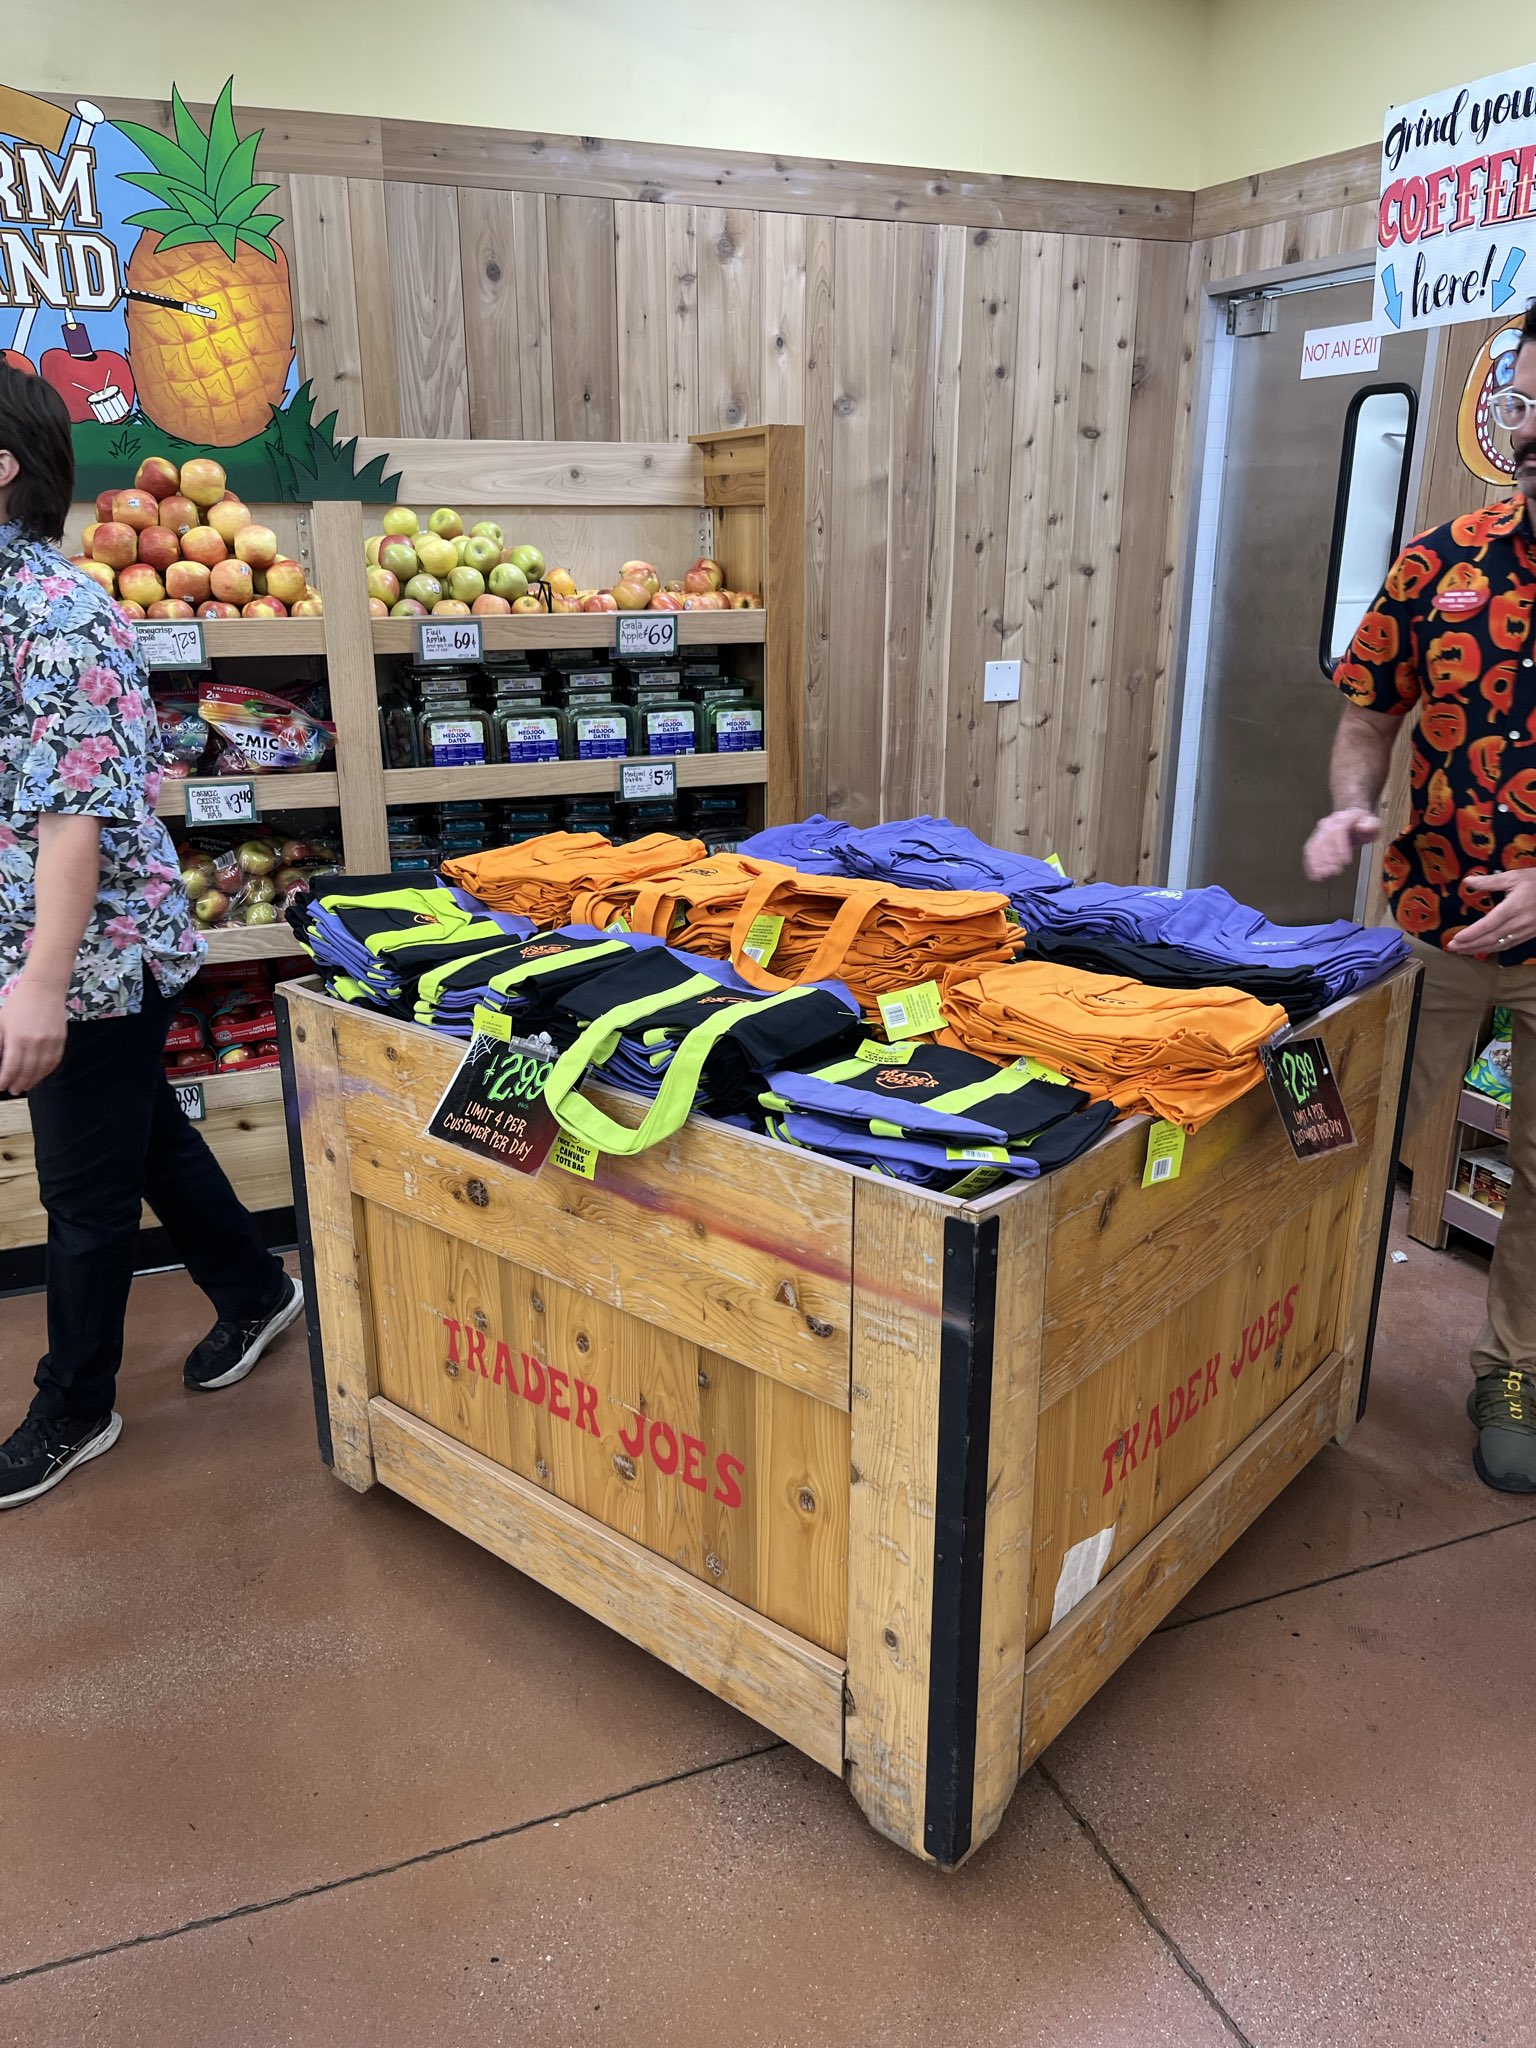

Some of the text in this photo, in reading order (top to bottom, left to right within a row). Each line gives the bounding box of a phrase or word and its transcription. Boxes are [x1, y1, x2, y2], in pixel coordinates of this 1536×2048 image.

[1384, 86, 1536, 171] grind you
[1378, 144, 1536, 249] COFFEE
[0, 228, 121, 311] ND
[1412, 244, 1498, 318] here!
[1304, 336, 1378, 362] NOT AN EXIT
[425, 628, 442, 637] Fuji
[621, 619, 643, 630] Gala
[213, 686, 237, 694] AMAZING
[235, 732, 280, 750] SMIC
[245, 748, 276, 762] CRISP
[201, 805, 220, 813] APPLE
[482, 1053, 554, 1103] $2.99
[464, 1100, 528, 1138] LIMIT 4 PER
[1312, 1102, 1328, 1119] PER
[443, 1111, 534, 1162] CUSTOMER PER DAY
[1317, 1121, 1334, 1140] PER
[1330, 1118, 1345, 1137] DAY
[555, 1154, 586, 1173] TOTE BAG
[559, 1146, 585, 1164] CANVAS
[1101, 1283, 1299, 1497] TRADER JOES
[442, 1317, 746, 1509] TRADER JOES
